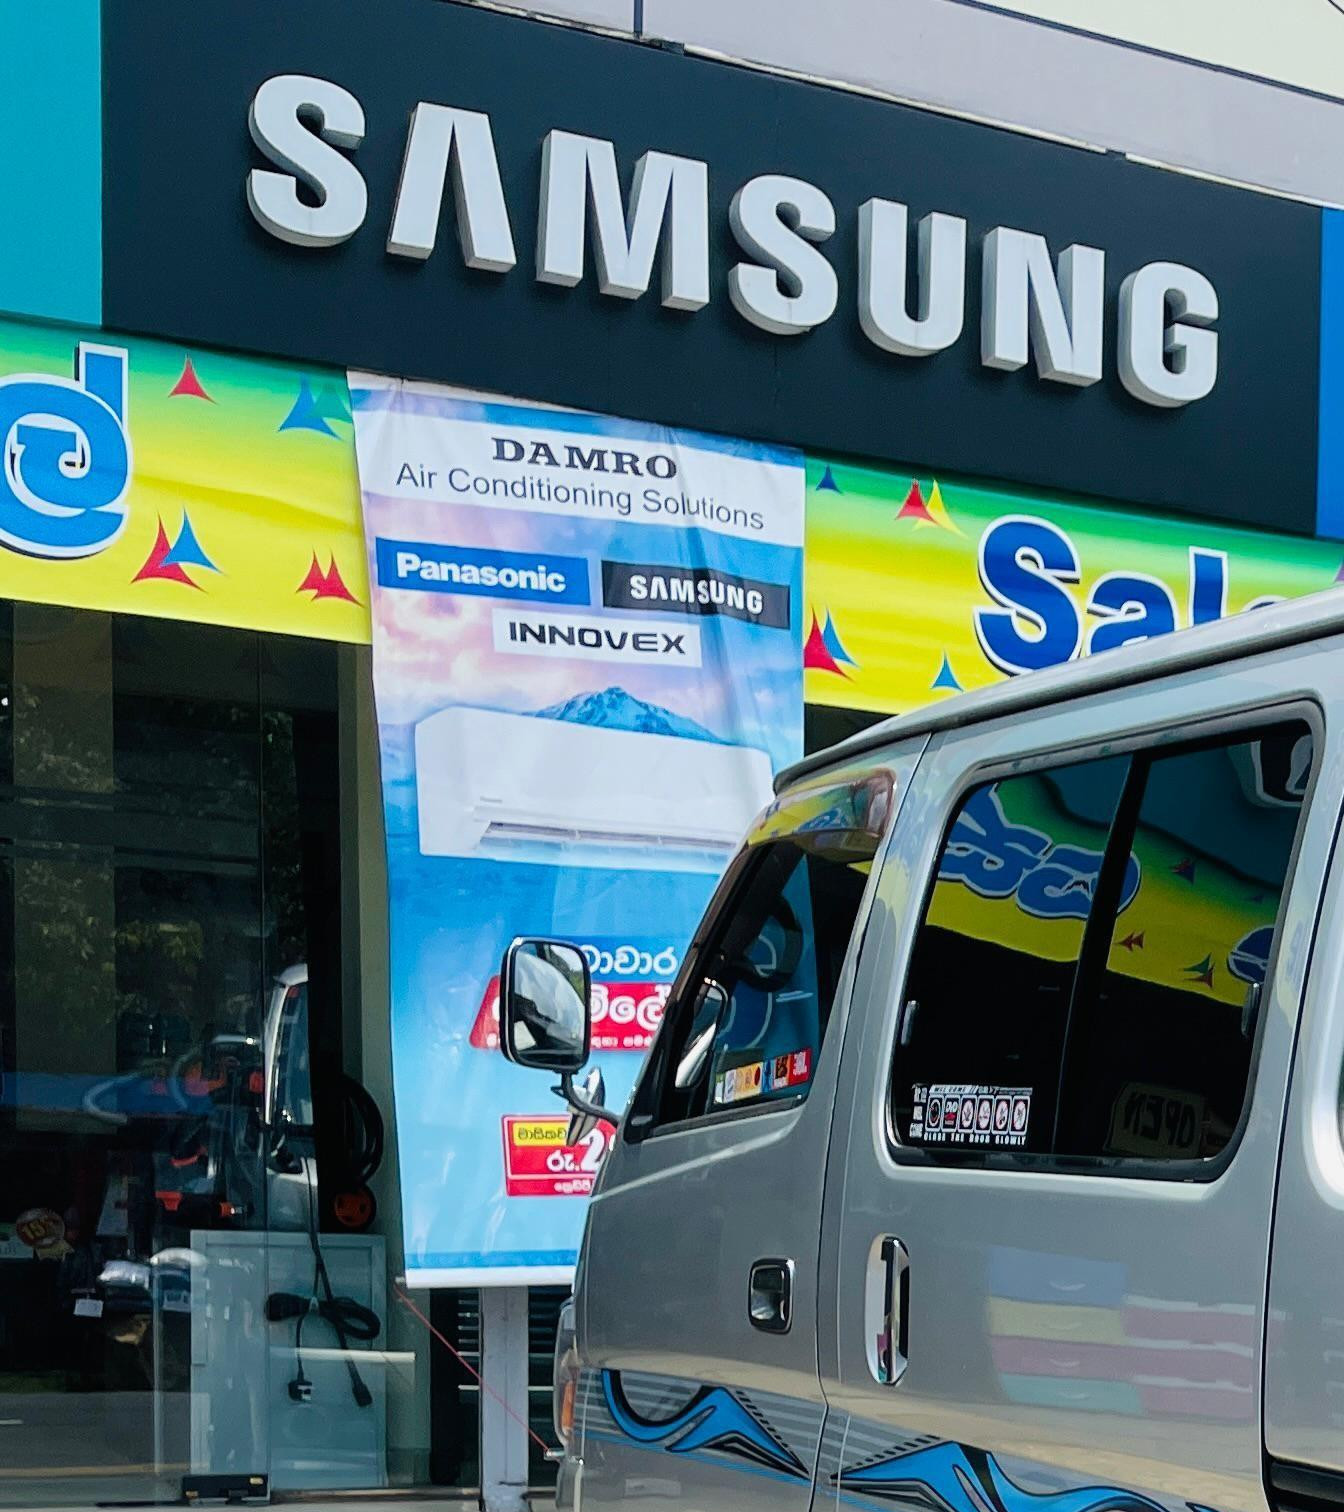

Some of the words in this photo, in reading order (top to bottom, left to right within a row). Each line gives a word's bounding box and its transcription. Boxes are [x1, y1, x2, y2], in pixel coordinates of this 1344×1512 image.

[246, 74, 1220, 409] SAMSUNG
[491, 436, 678, 480] DAMRO
[396, 461, 438, 490] Air
[447, 467, 633, 516] Conditioning
[642, 489, 765, 531] Solutions
[396, 551, 567, 594] Panasonic
[629, 574, 764, 616] SAMSUNG
[974, 514, 1290, 677] Sal
[508, 620, 687, 655] INNOVEX
